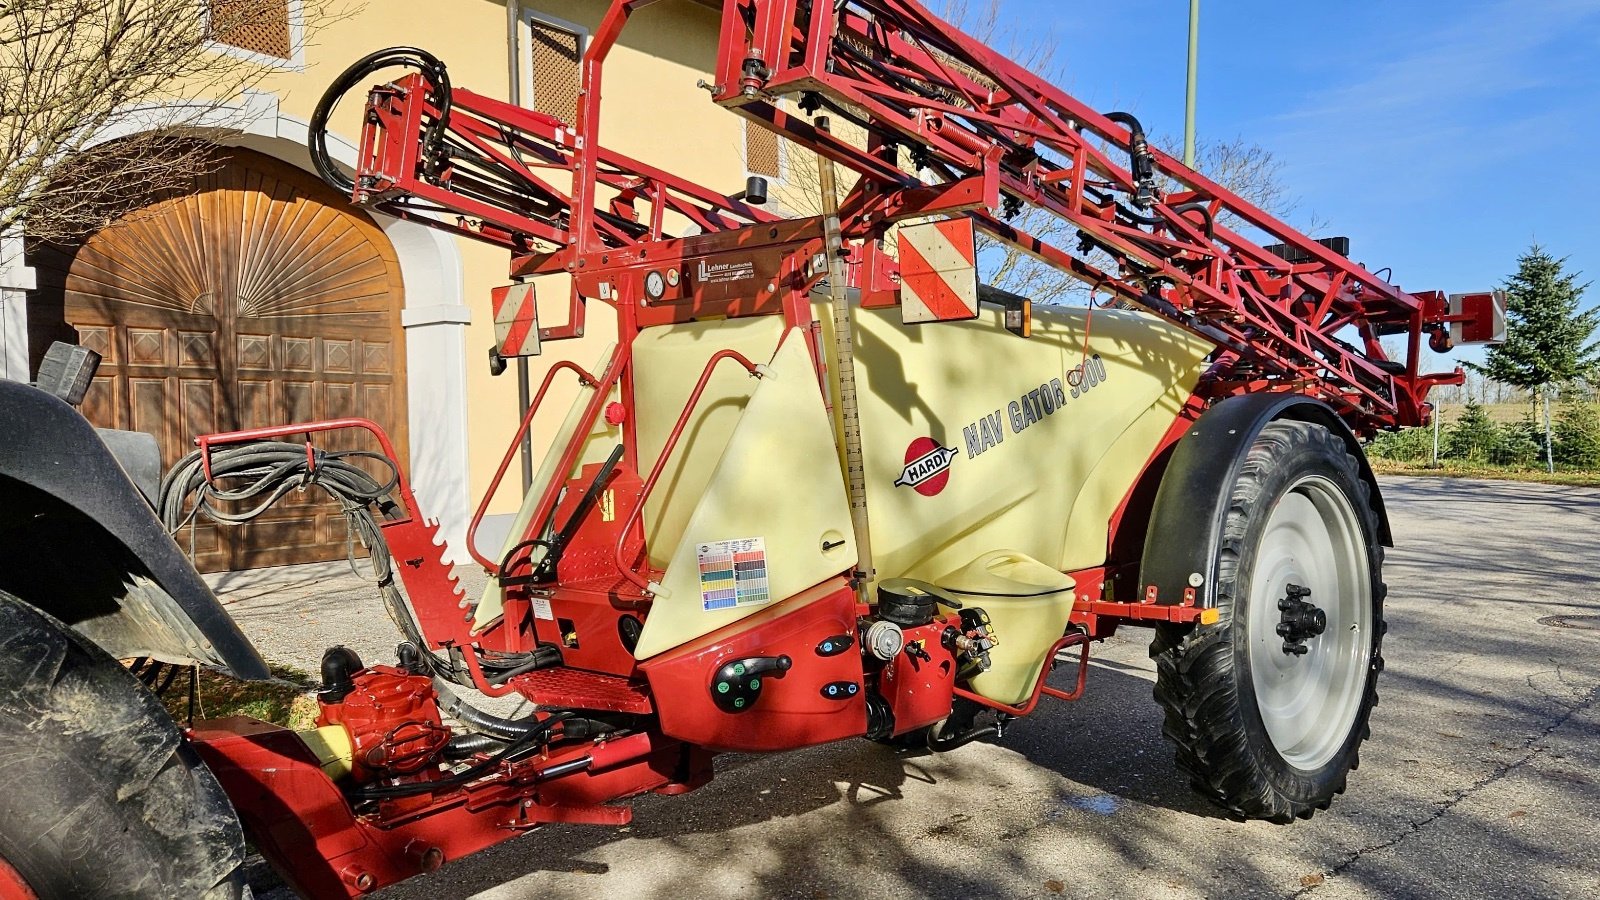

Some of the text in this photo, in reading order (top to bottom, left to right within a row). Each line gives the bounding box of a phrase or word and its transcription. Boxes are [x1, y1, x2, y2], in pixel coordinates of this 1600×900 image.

[708, 263, 729, 272] Lehner
[962, 353, 1107, 459] NAV GATOR 3000
[907, 451, 948, 482] HARDI
